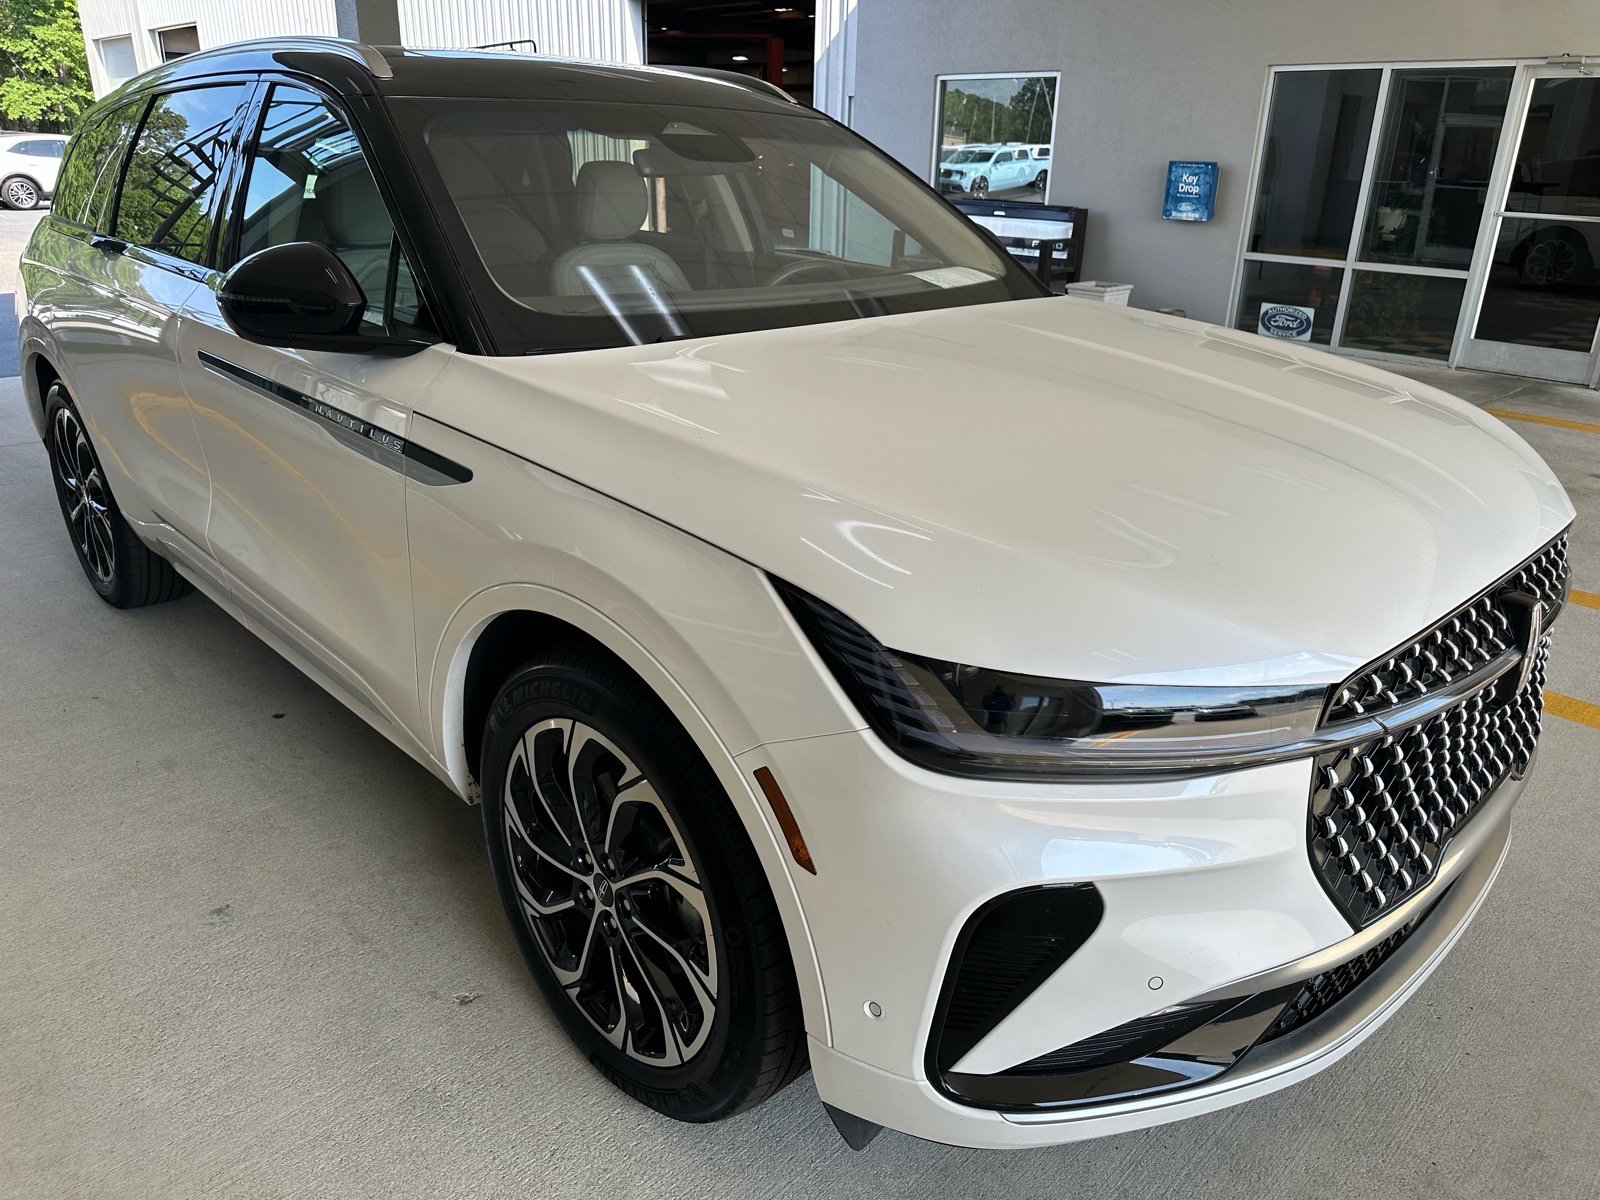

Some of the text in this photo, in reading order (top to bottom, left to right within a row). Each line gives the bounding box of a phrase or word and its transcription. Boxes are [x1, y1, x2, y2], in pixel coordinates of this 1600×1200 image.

[1182, 173, 1199, 184] Key
[1178, 184, 1200, 194] Drop
[1031, 240, 1063, 250] FD
[1267, 306, 1307, 320] AUTHORIZED
[1270, 314, 1301, 328] Ford
[1269, 328, 1298, 337] SERVICE
[315, 404, 402, 450] NAUTILUS
[512, 680, 593, 710] MICHELIN
